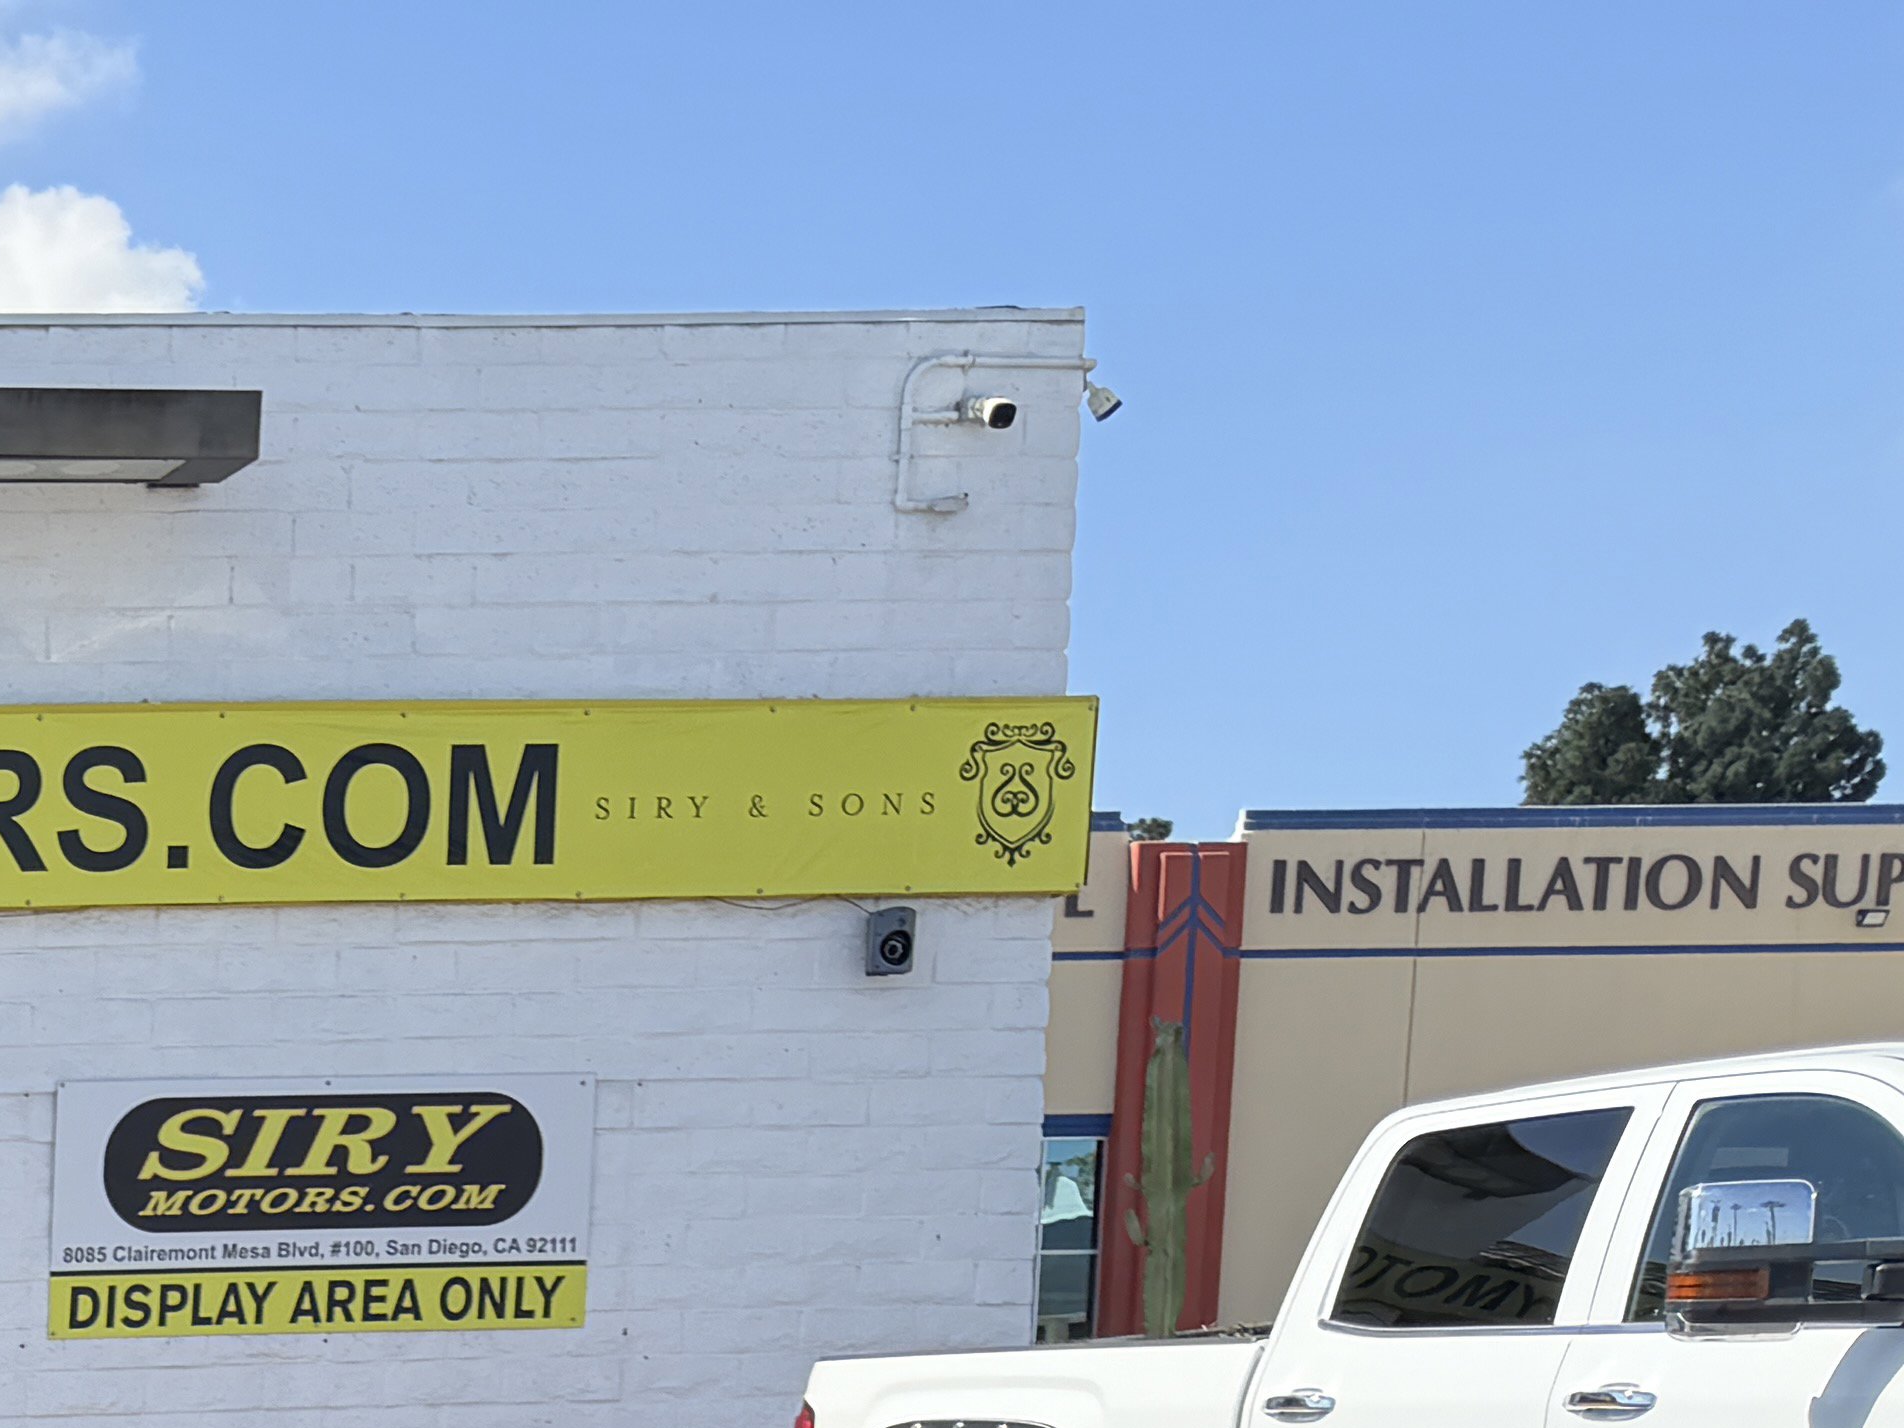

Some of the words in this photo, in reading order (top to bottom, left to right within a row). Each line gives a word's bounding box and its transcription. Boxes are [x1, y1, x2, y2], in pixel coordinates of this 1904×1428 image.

[594, 793, 709, 821] SIRY
[747, 792, 770, 820] &
[808, 789, 937, 820] SONS
[1269, 853, 1761, 915] INSTALLATION
[1785, 852, 1904, 910] SUP
[137, 1102, 512, 1181] SIRY
[138, 1184, 506, 1218] MOTORS.COM
[63, 1246, 108, 1264] 8085
[112, 1244, 217, 1263] Clairemont
[222, 1243, 272, 1261] Mesa
[277, 1241, 325, 1260] Blvd,
[329, 1240, 380, 1259] #100,
[385, 1239, 422, 1257] San
[428, 1237, 488, 1259] Diego,
[493, 1237, 522, 1254] CA
[526, 1236, 578, 1254] 92111
[68, 1279, 278, 1330] DISPLAY
[291, 1278, 423, 1325] AREA
[439, 1275, 566, 1322] ONLY
